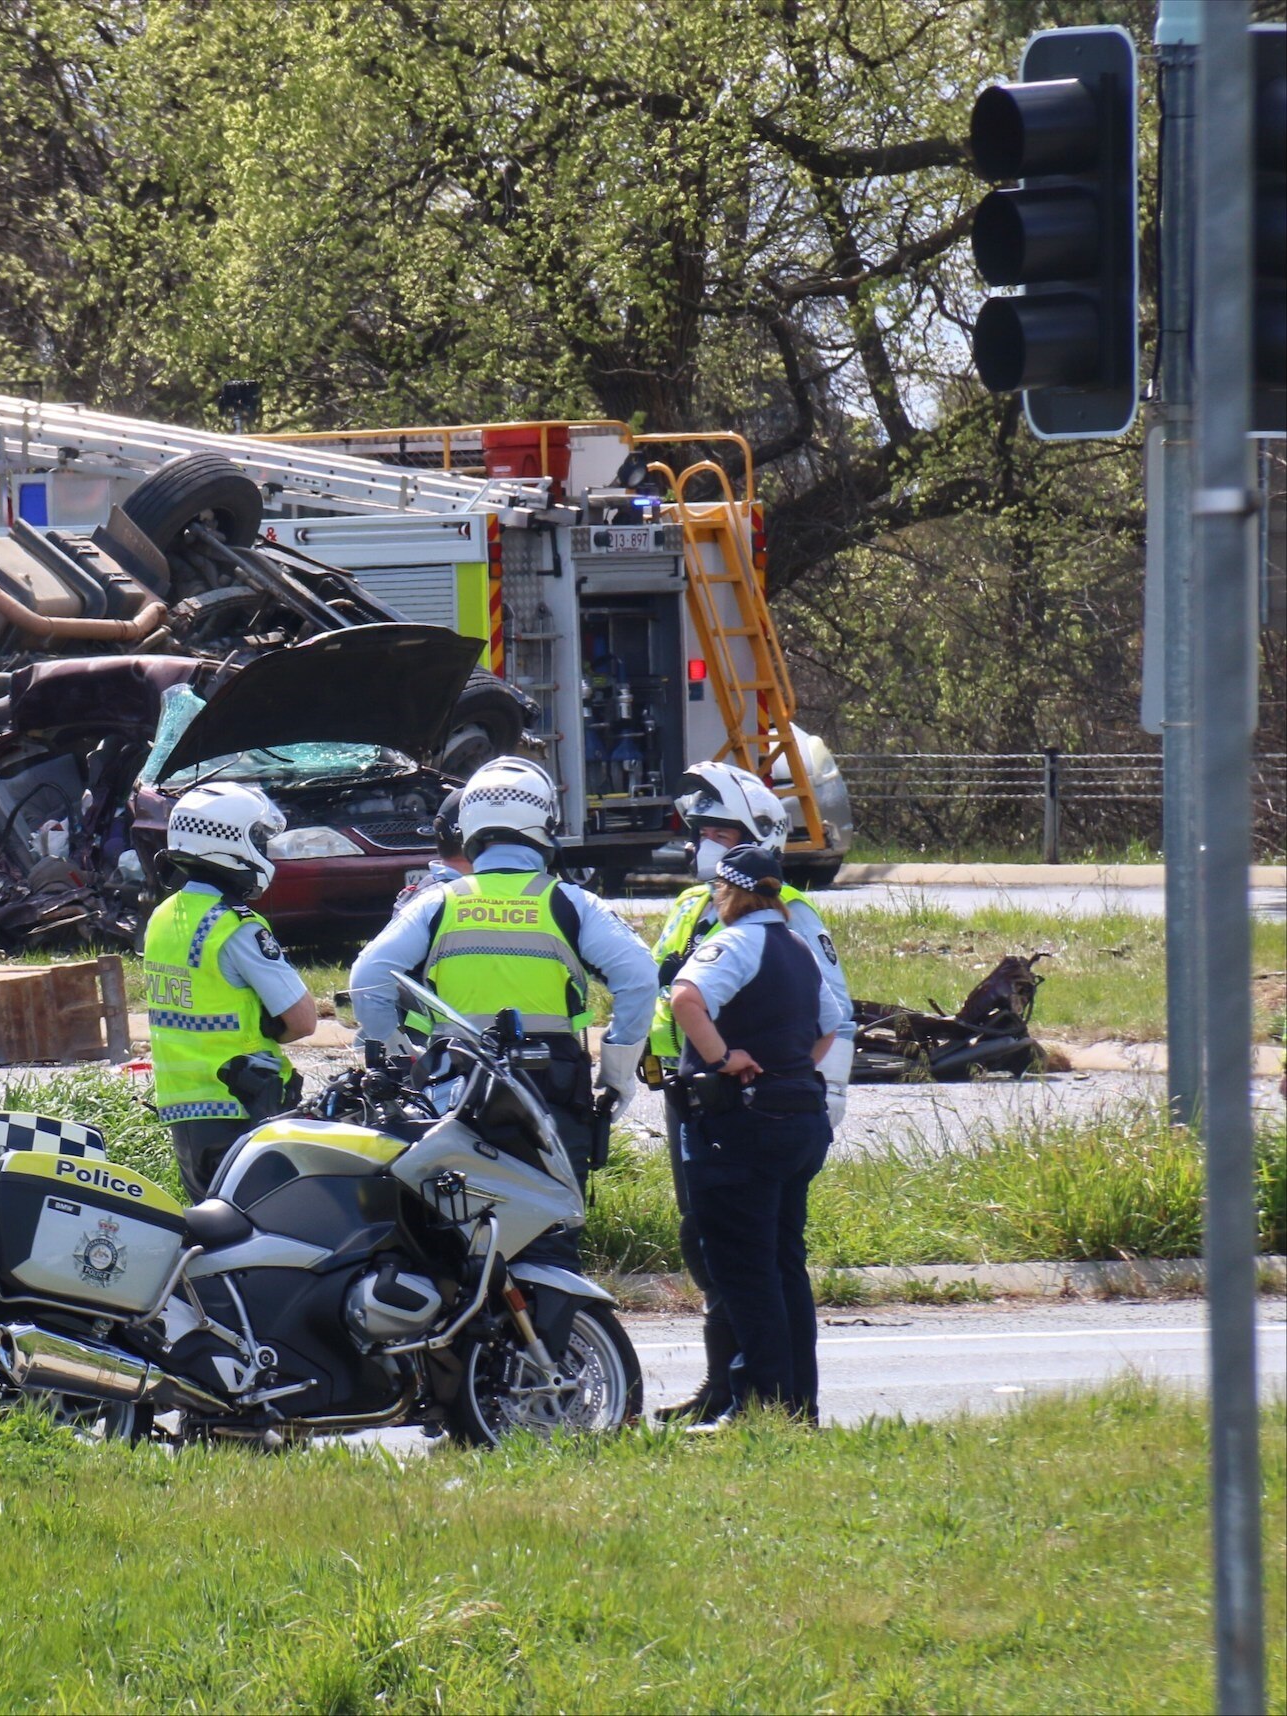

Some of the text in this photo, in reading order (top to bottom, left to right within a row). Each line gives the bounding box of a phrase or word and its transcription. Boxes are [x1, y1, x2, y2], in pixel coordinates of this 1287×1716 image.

[458, 898, 504, 906] AUSTRALIAN
[457, 907, 539, 924] POLICE
[56, 1160, 143, 1197] Police
[55, 1201, 74, 1212] BMW
[85, 1267, 108, 1279] POLICE
